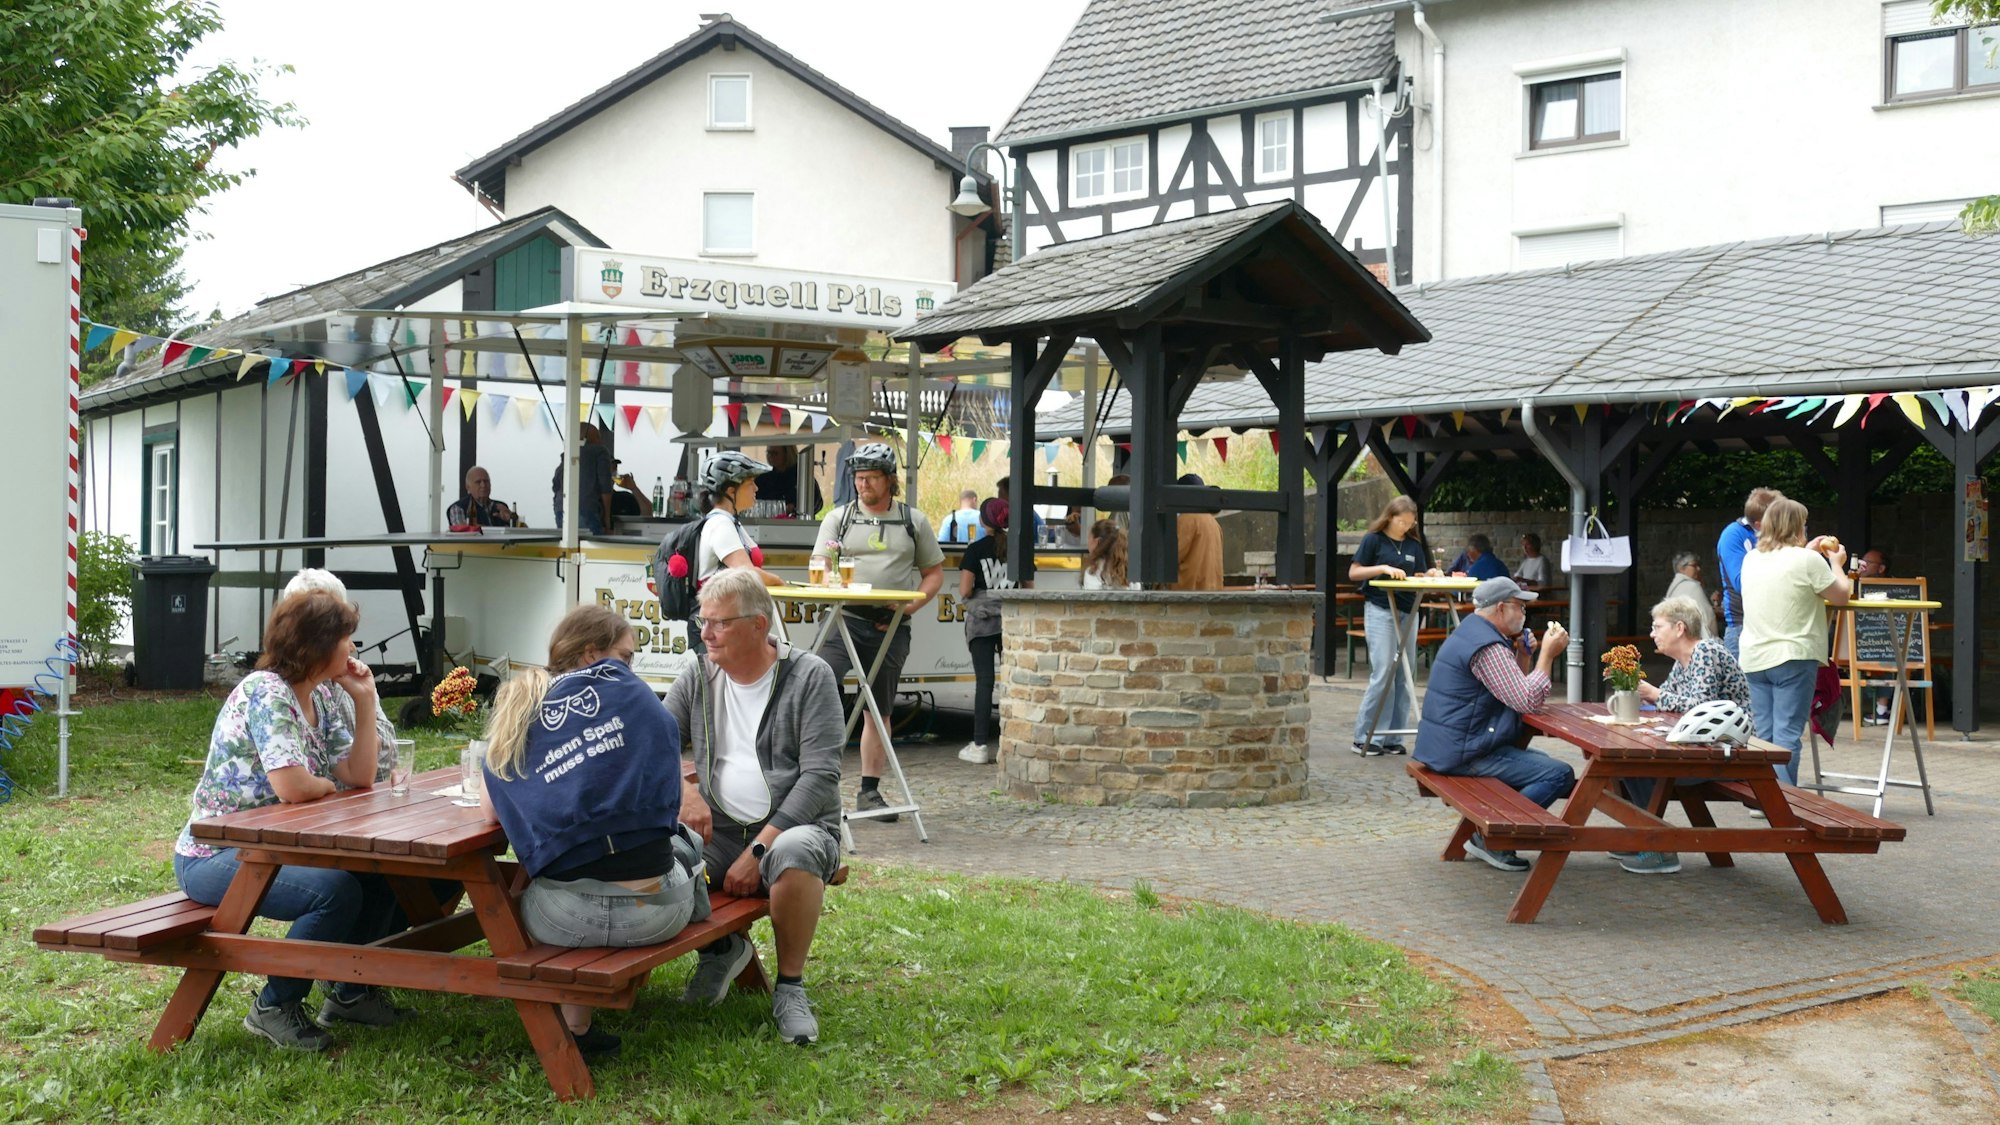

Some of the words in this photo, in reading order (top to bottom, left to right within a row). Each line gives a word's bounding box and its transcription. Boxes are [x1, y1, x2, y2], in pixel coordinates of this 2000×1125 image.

[639, 265, 818, 310] Erzquell
[826, 282, 902, 317] Pils
[633, 626, 687, 655] Pils
[582, 715, 625, 742] Spaß
[543, 751, 585, 784] muss
[586, 732, 625, 758] sein!
